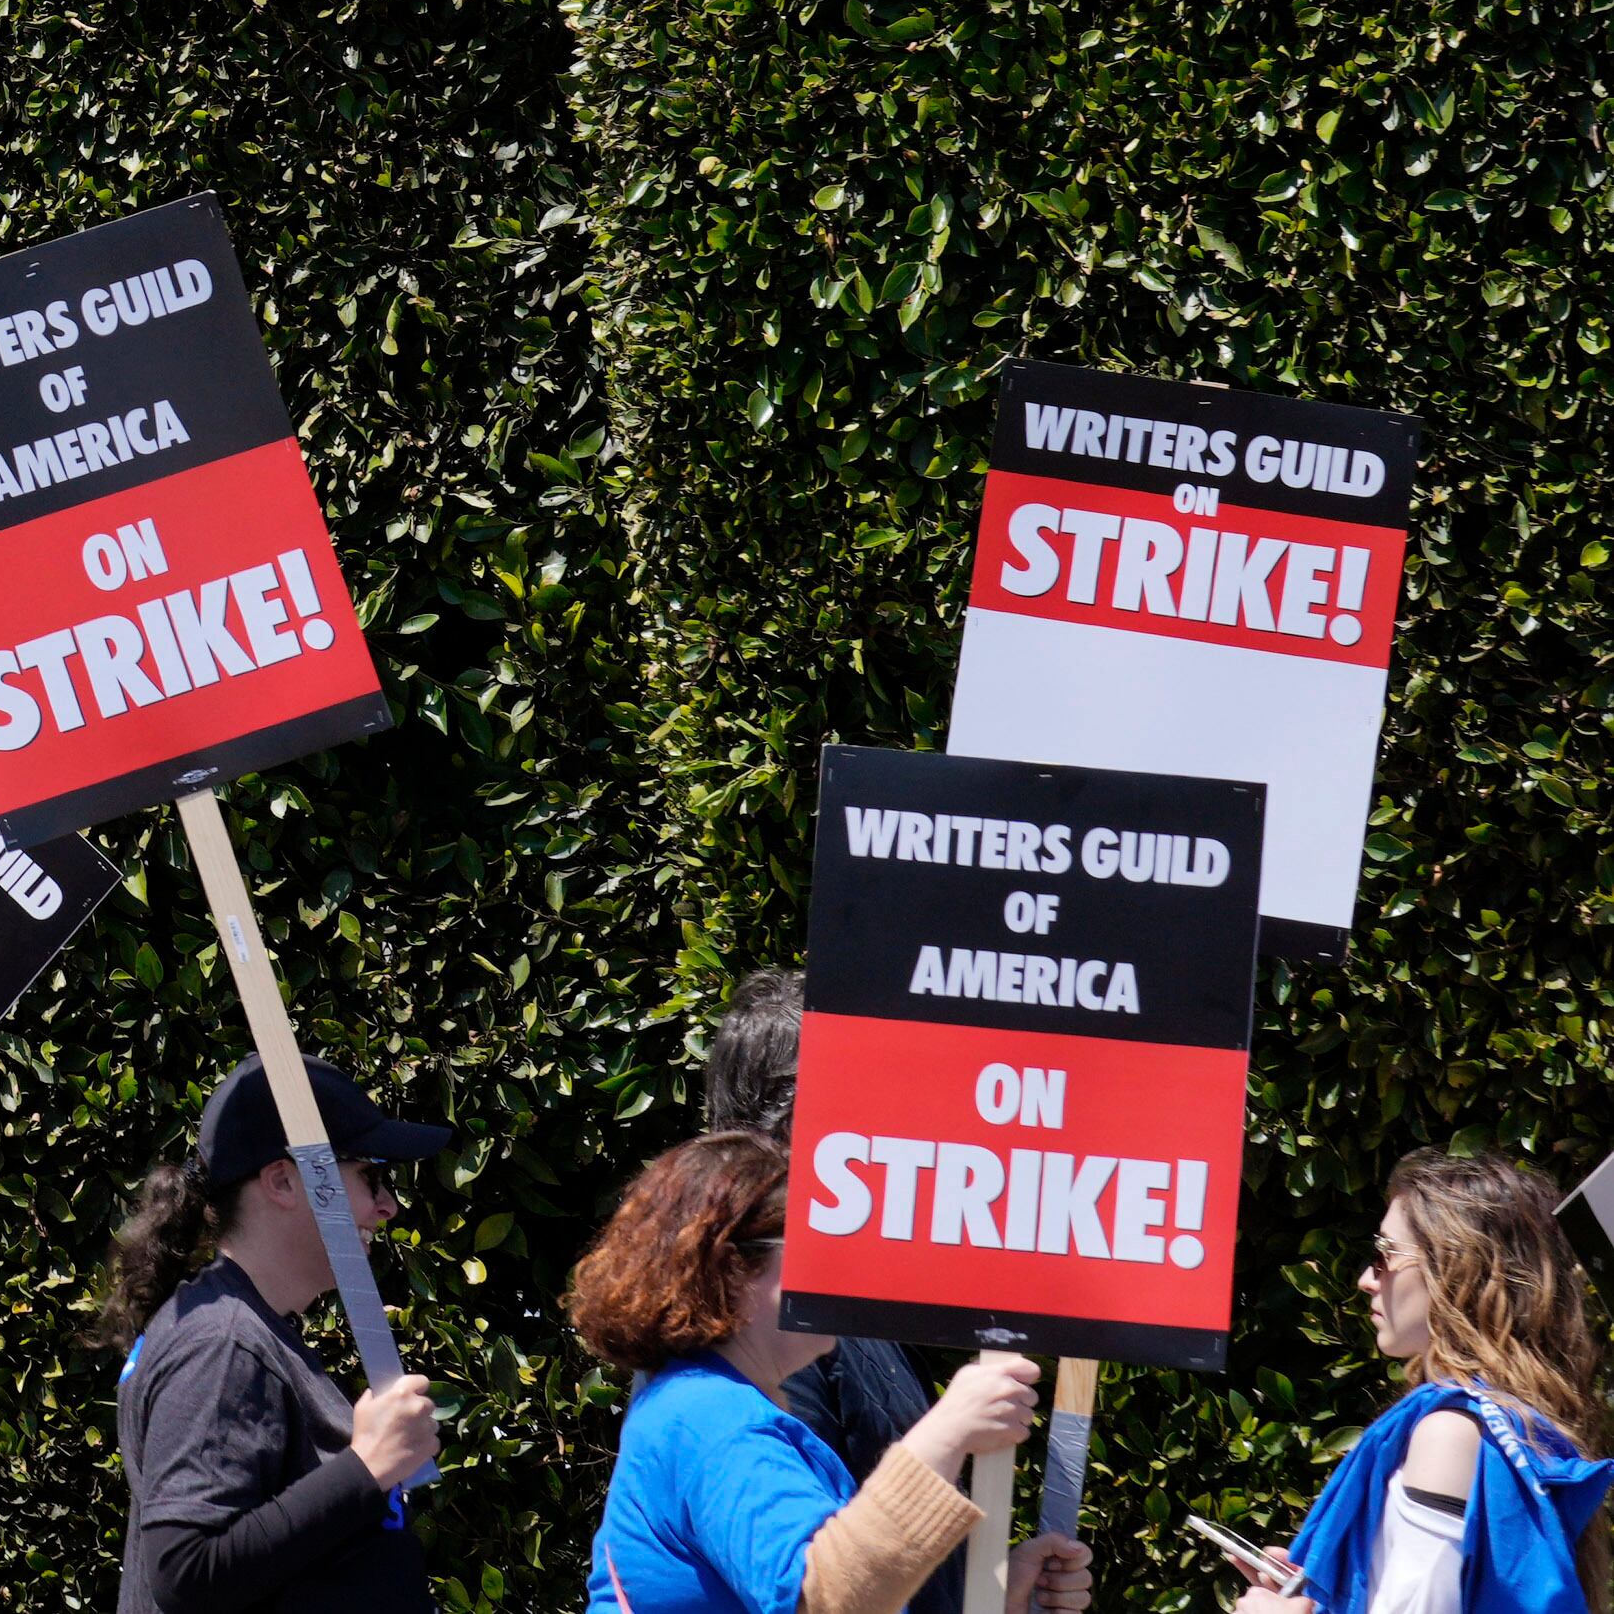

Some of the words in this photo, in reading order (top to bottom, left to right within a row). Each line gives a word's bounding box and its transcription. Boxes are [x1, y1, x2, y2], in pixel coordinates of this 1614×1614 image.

[82, 260, 212, 335] GUILD
[40, 366, 87, 412] OF
[1026, 402, 1236, 476] WRITERS
[1246, 437, 1384, 497] GUILD
[1174, 484, 1219, 516] ON
[83, 518, 168, 591] ON
[1001, 504, 1370, 645] STRIKE!
[846, 807, 1071, 873] WRITERS
[1082, 828, 1229, 887] GUILD
[1005, 892, 1058, 934] OF
[910, 946, 1138, 1013] AMERICA
[976, 1063, 1066, 1129] ON
[809, 1132, 1208, 1269] STRIKE!
